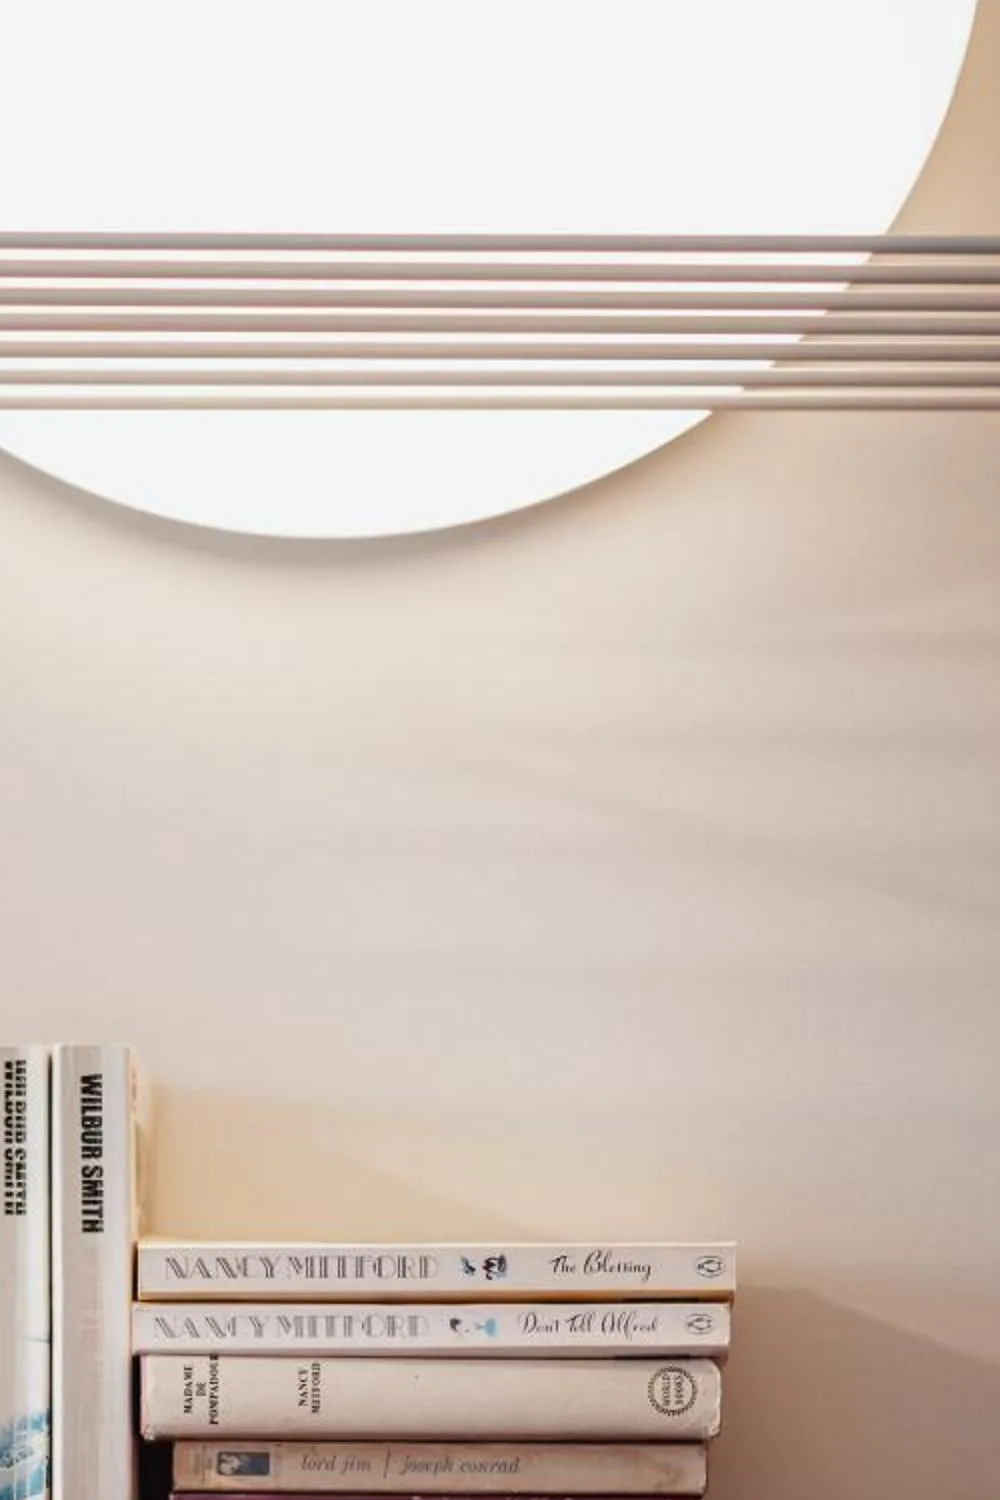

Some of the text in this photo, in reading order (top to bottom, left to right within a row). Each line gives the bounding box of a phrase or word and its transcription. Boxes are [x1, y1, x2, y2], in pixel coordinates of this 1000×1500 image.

[80, 1074, 104, 1233] WILBUR SMITH
[164, 1254, 440, 1280] NANCY MITFORD
[550, 1248, 652, 1283] The Blessing
[153, 1313, 430, 1339] NANCY MITFORD
[565, 1311, 594, 1334] Tell
[600, 1311, 658, 1341] Alfred
[183, 1364, 194, 1415] MADAME
[301, 1454, 371, 1475] lord jim
[401, 1456, 520, 1476] joseph conrad
